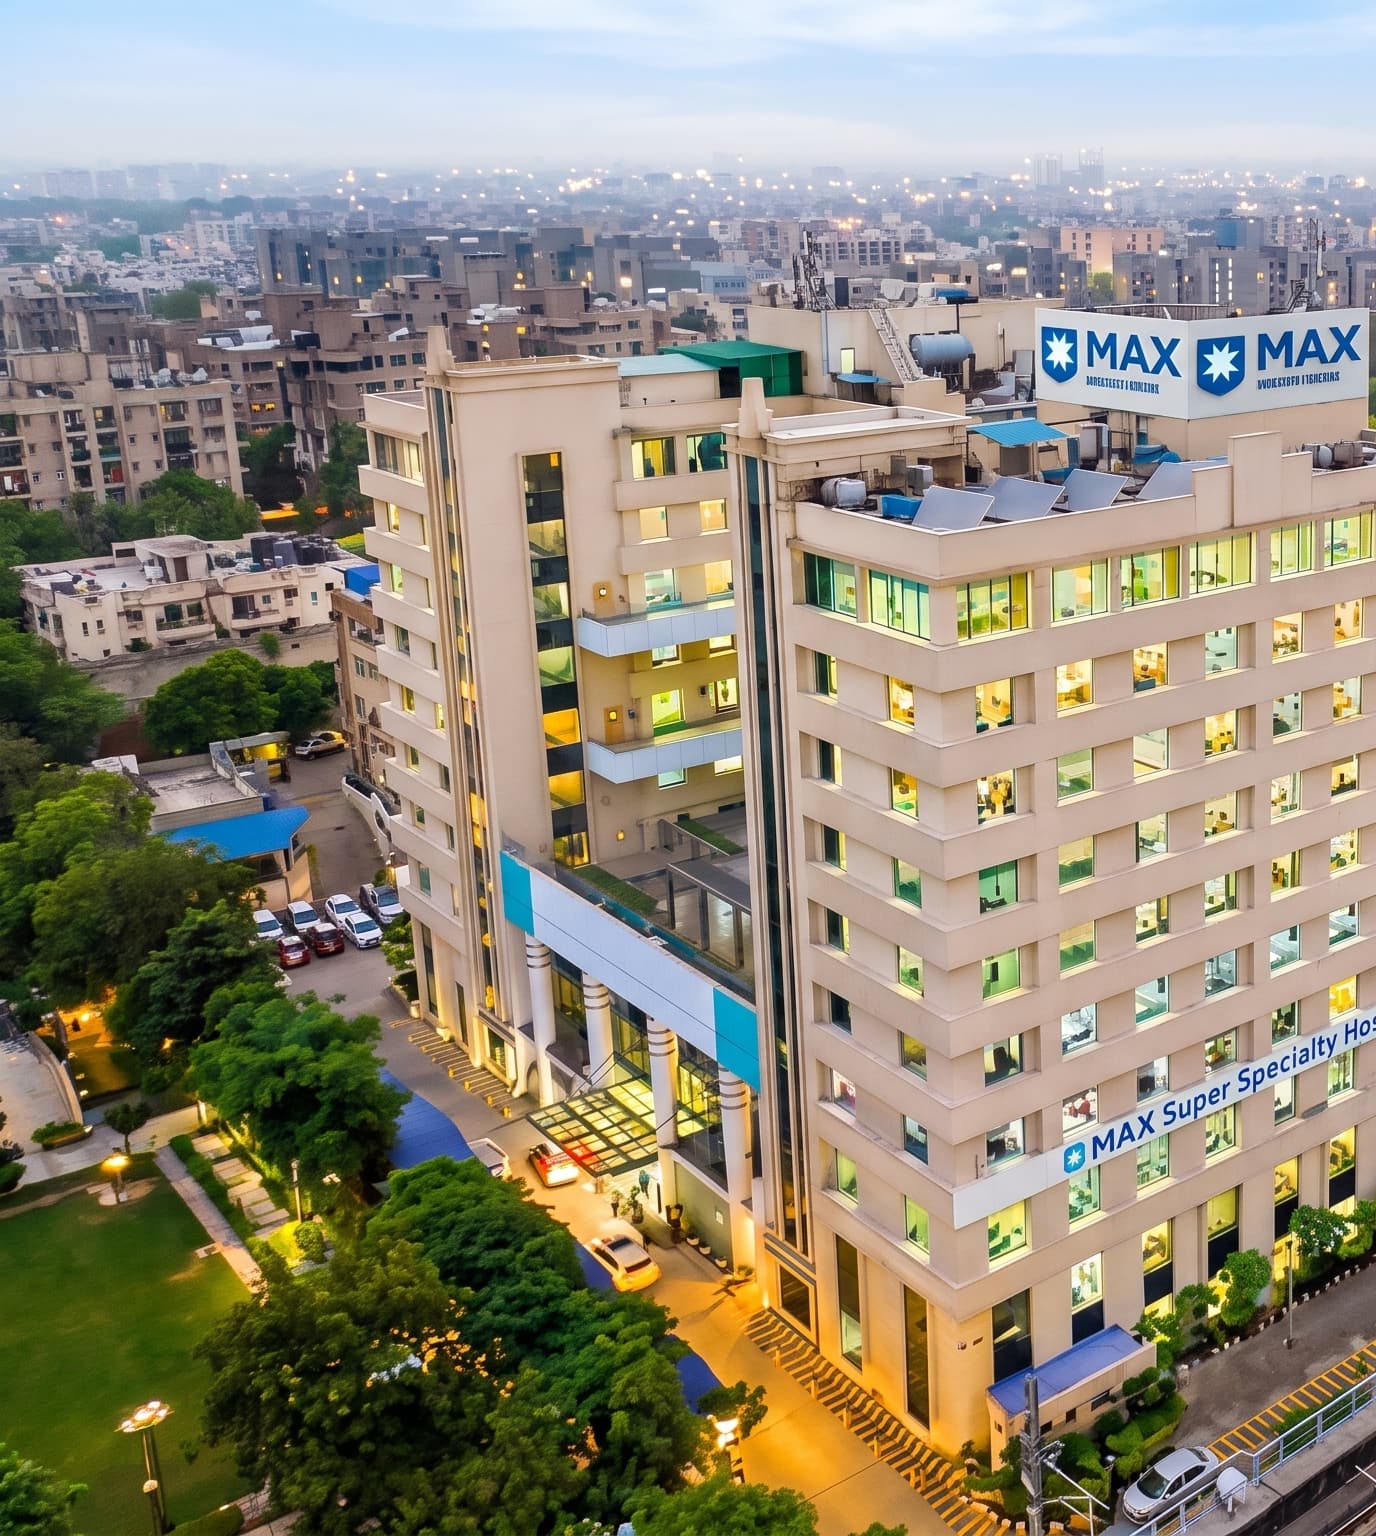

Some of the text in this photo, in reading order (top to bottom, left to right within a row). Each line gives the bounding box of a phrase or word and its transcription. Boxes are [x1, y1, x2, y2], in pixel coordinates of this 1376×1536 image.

[1087, 330, 1182, 377] MAX
[1258, 324, 1361, 371] MAX
[1092, 1110, 1155, 1160] MAX
[1163, 1081, 1230, 1126] Super
[1237, 1033, 1338, 1092] Specialty
